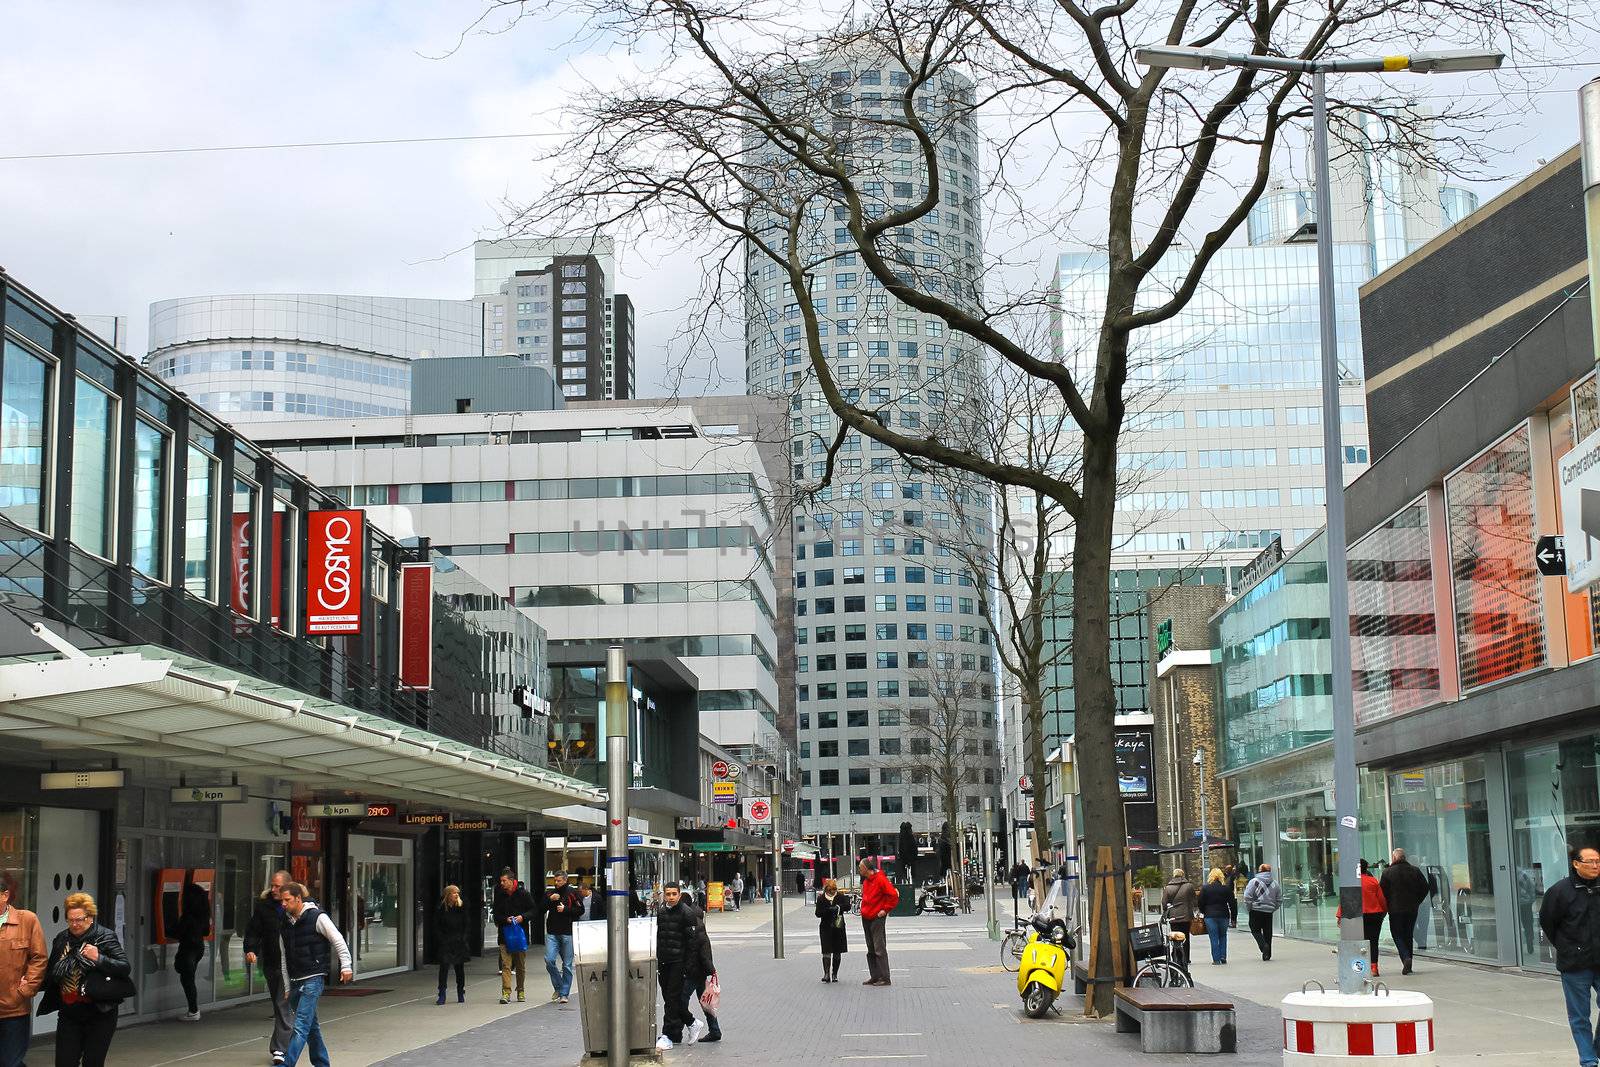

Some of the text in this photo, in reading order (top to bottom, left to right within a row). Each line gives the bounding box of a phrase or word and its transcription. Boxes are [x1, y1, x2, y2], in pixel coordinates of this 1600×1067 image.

[205, 791, 223, 800] kpn
[333, 808, 349, 816] kpn
[406, 815, 443, 825] Lingerie
[589, 968, 644, 981] AFAL
